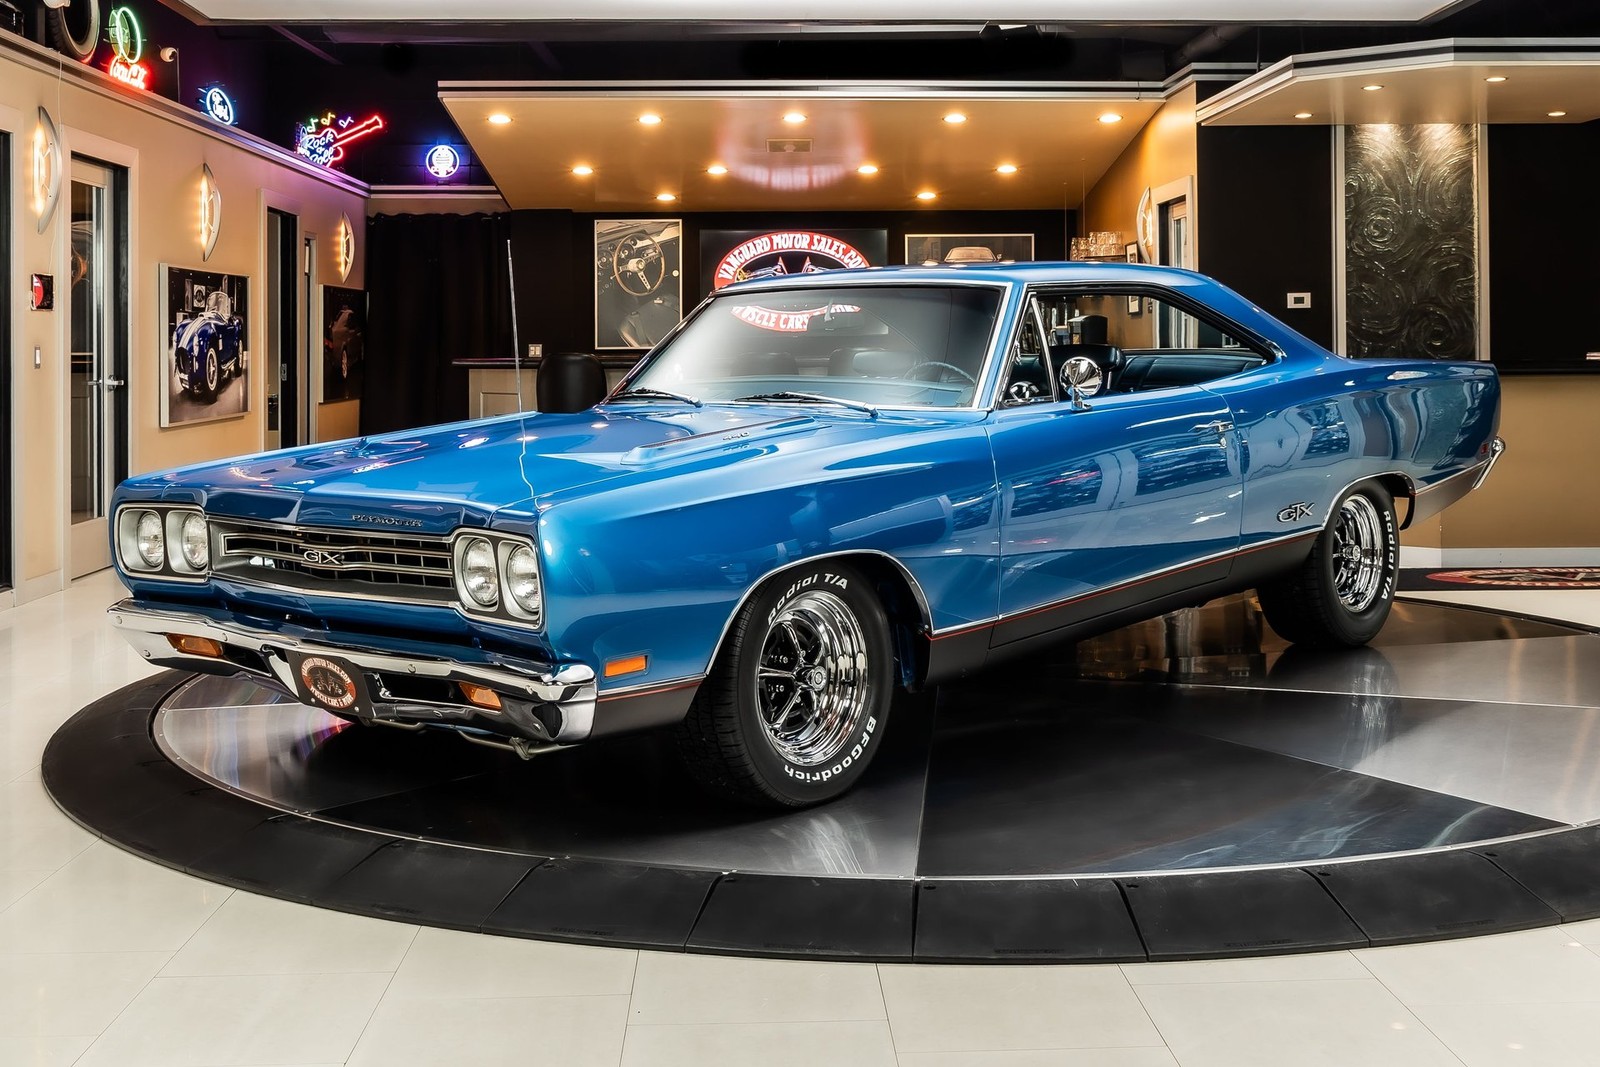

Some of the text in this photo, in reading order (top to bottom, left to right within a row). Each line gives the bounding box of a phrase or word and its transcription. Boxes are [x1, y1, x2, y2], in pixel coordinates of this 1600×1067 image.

[305, 130, 334, 150] Rock
[718, 236, 772, 280] VANGUARD
[771, 232, 811, 250] MOTOR
[779, 312, 811, 330] CARS
[351, 513, 424, 528] PLYMOUTH
[1276, 501, 1316, 523] GTX
[303, 550, 342, 565] GTX
[823, 572, 849, 590] T/A
[1381, 576, 1393, 600] T/A
[783, 715, 877, 784] BFGoodrich
